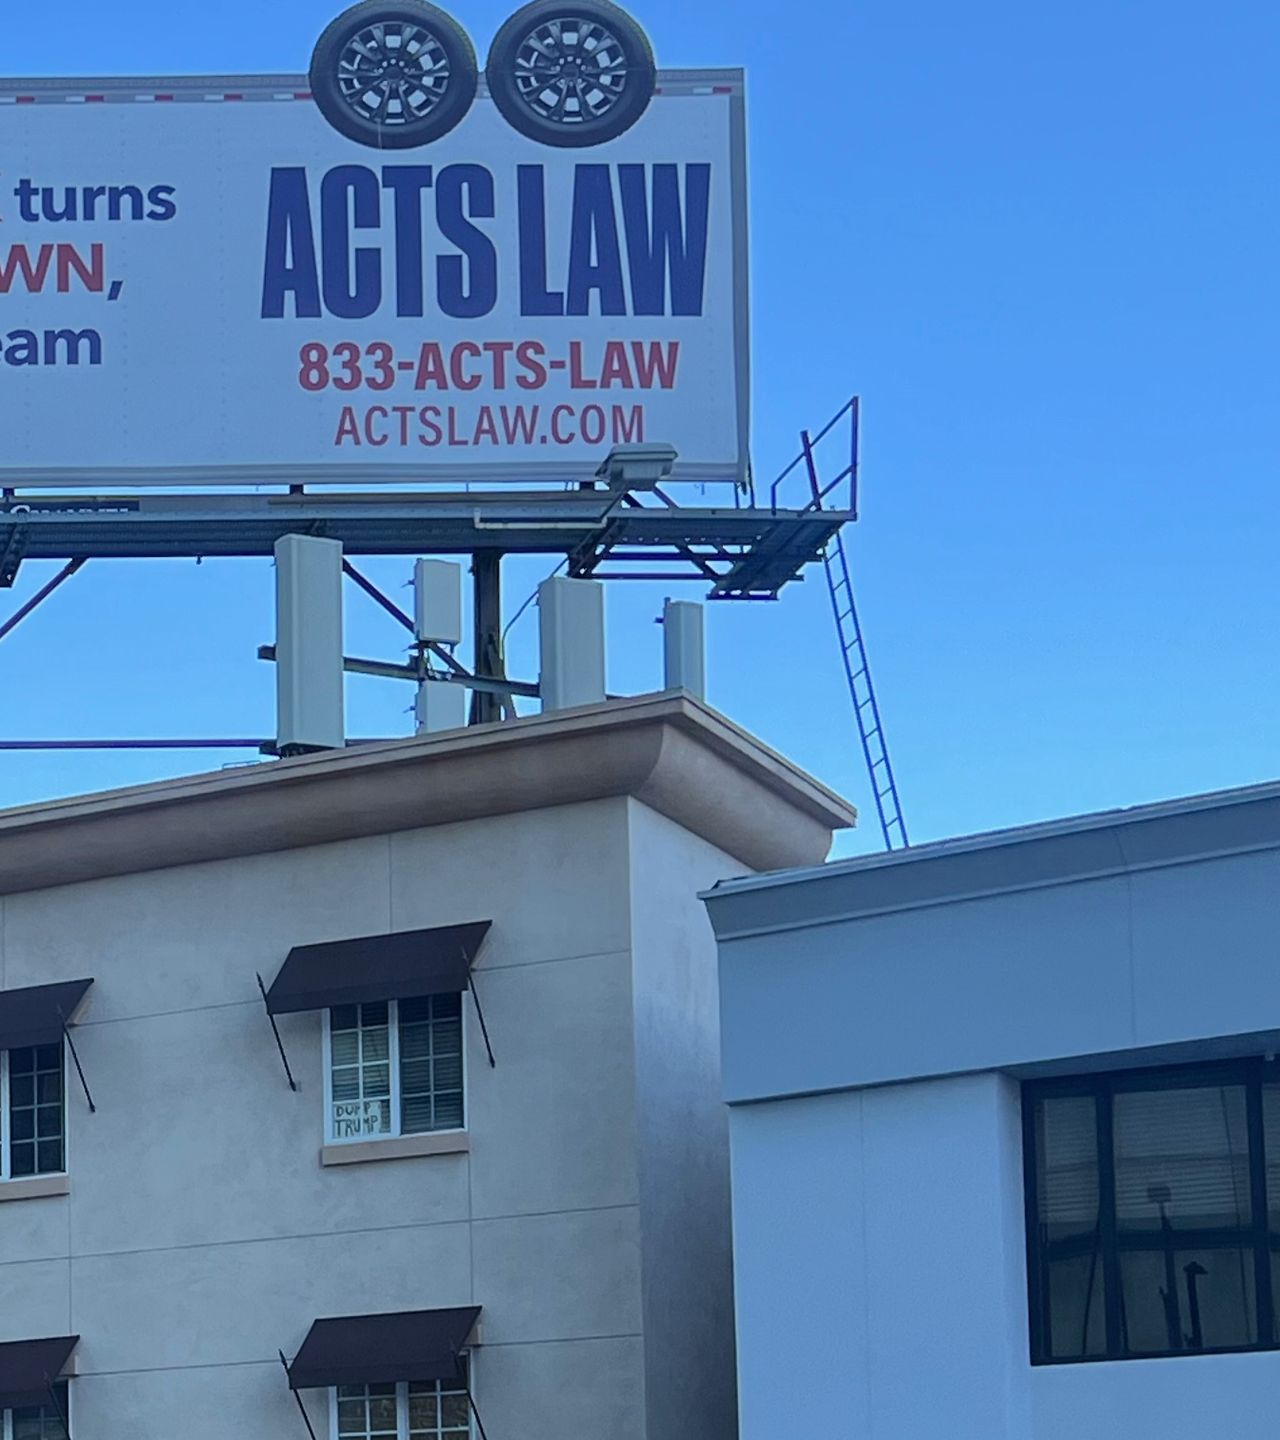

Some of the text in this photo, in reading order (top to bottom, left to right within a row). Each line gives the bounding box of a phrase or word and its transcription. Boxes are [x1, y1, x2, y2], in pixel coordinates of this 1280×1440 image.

[14, 179, 177, 222] turns
[260, 163, 711, 319] ACTS LAW
[299, 341, 679, 391] 833-ACTS-LAW
[335, 404, 643, 446] ACTSLAW.COM
